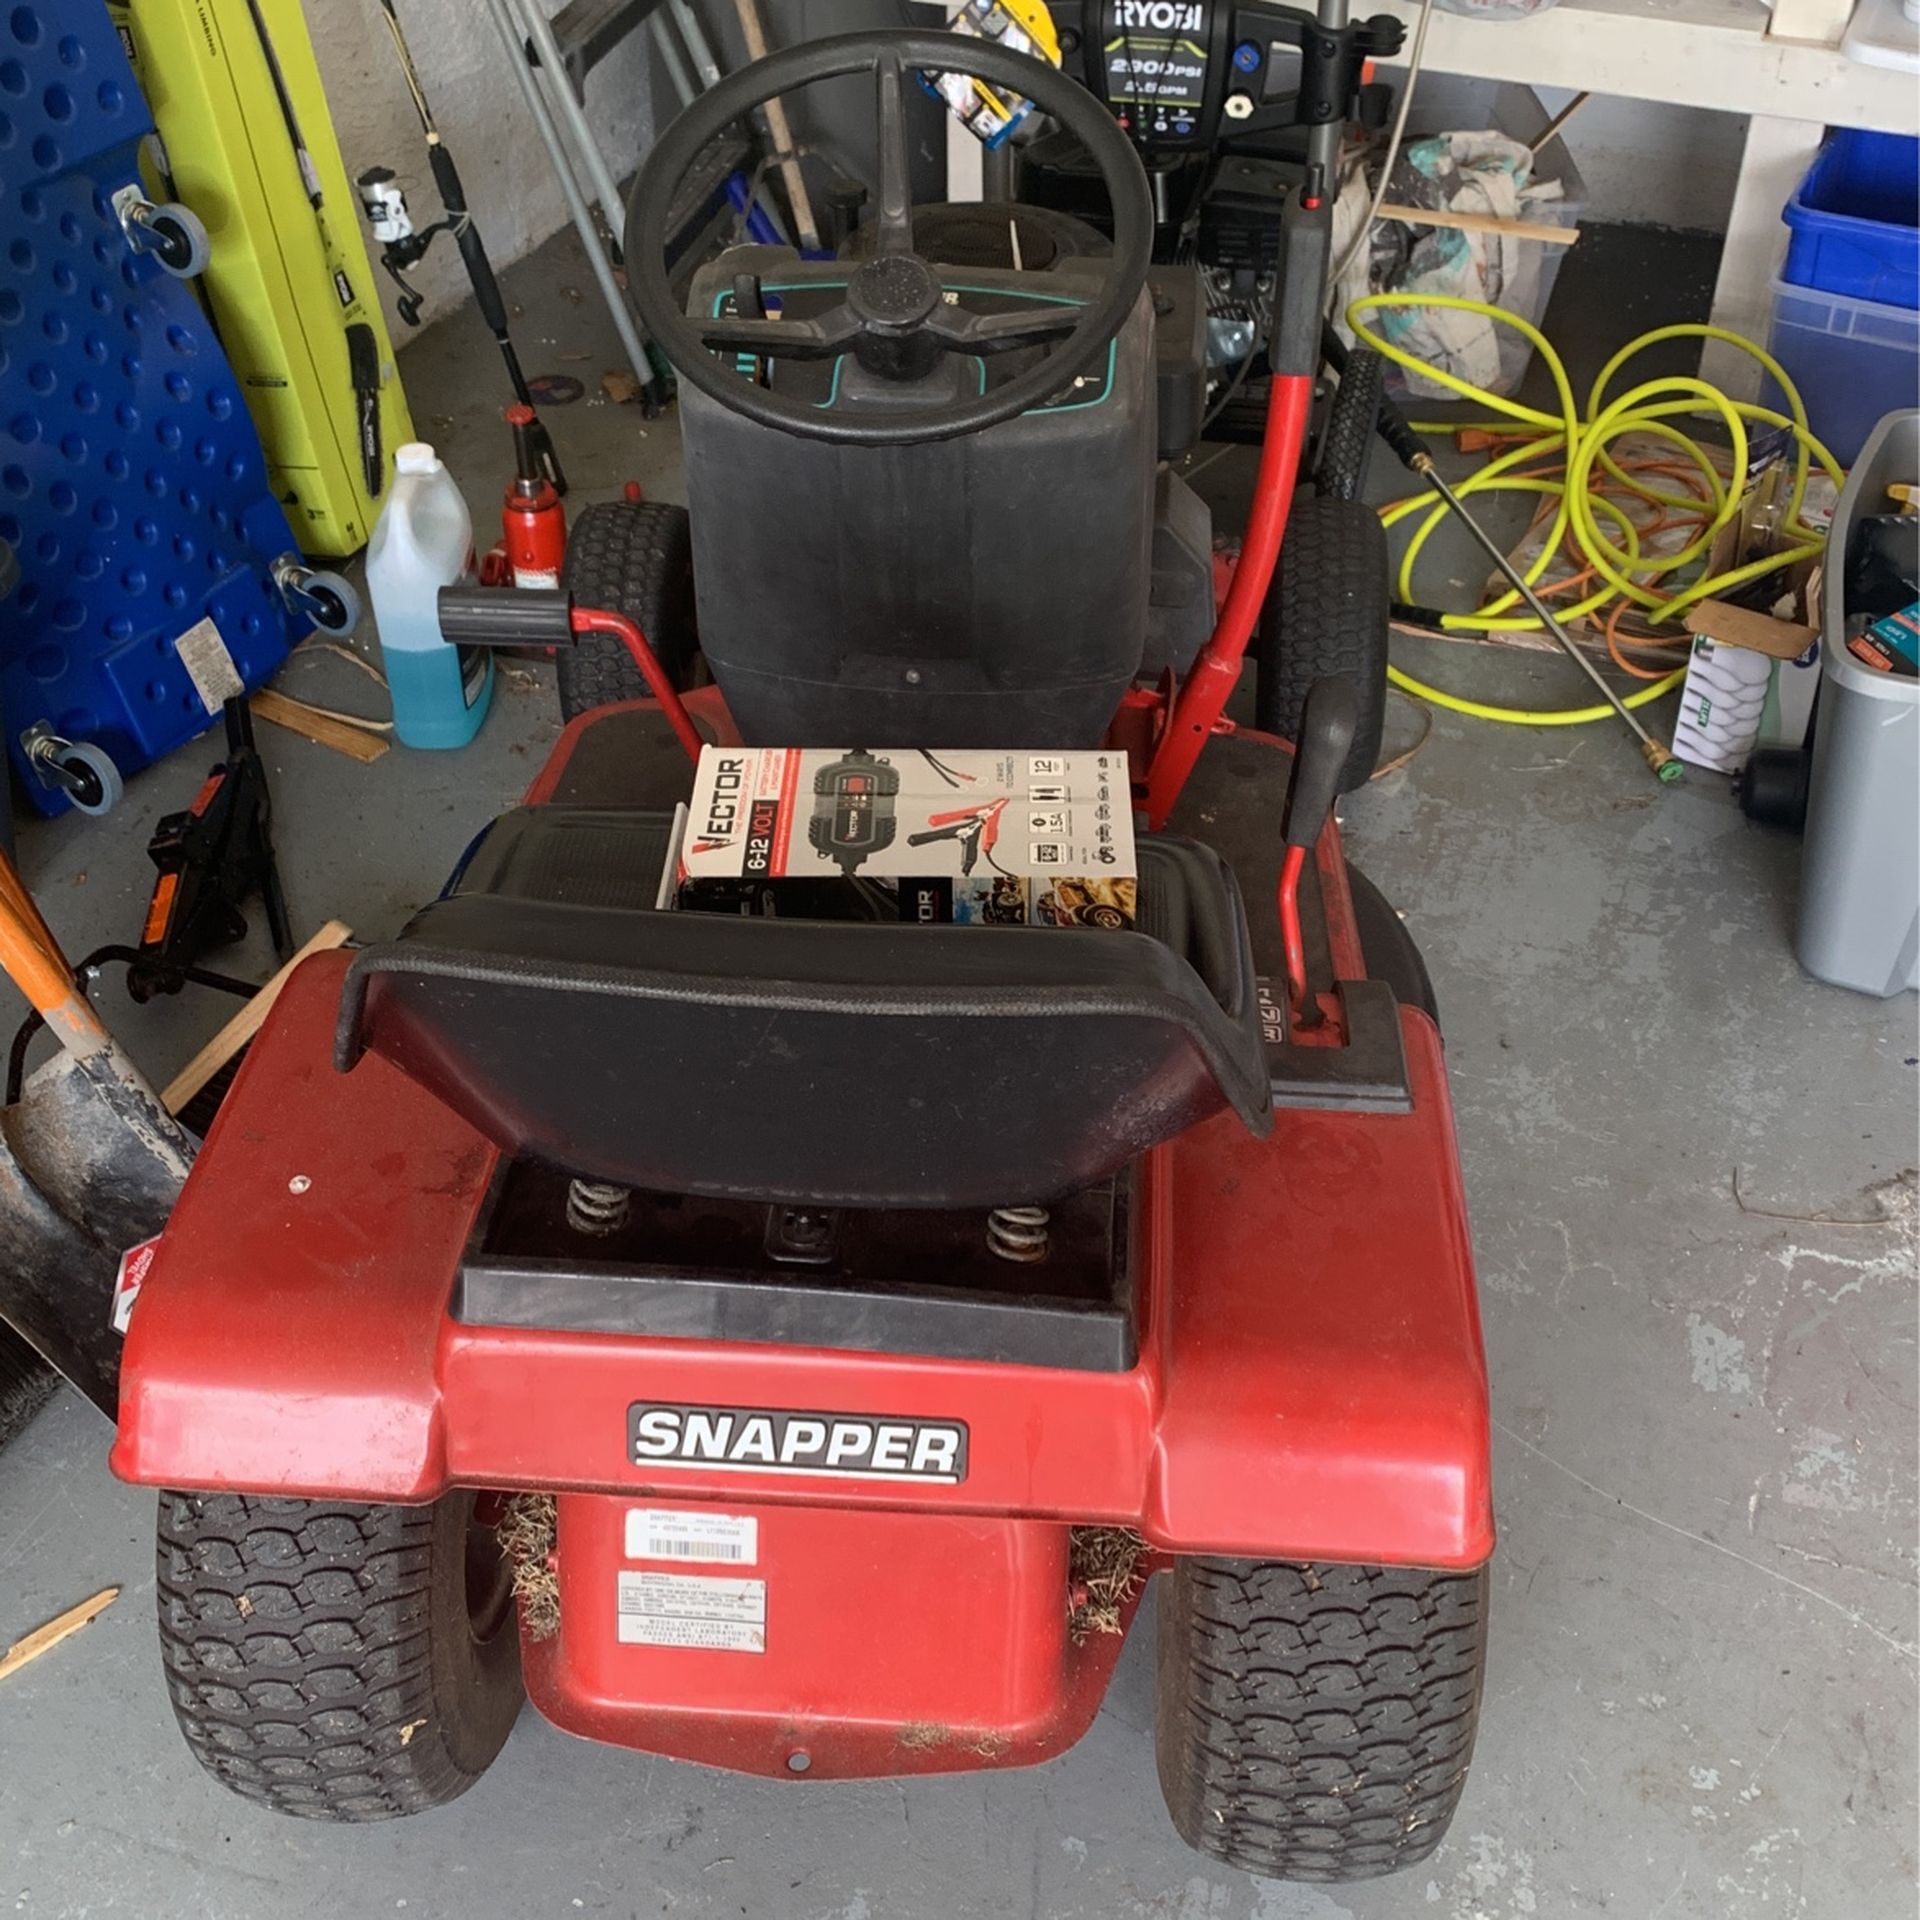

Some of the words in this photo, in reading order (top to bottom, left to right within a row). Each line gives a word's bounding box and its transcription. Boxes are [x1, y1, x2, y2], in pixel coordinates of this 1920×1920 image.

[1114, 0, 1204, 31] RYOBI
[1035, 760, 1052, 773] 12
[691, 758, 744, 854] VECTOR
[752, 802, 774, 837] VOLT
[747, 838, 769, 870] 6-12
[635, 1411, 959, 1472] SNAPPER
